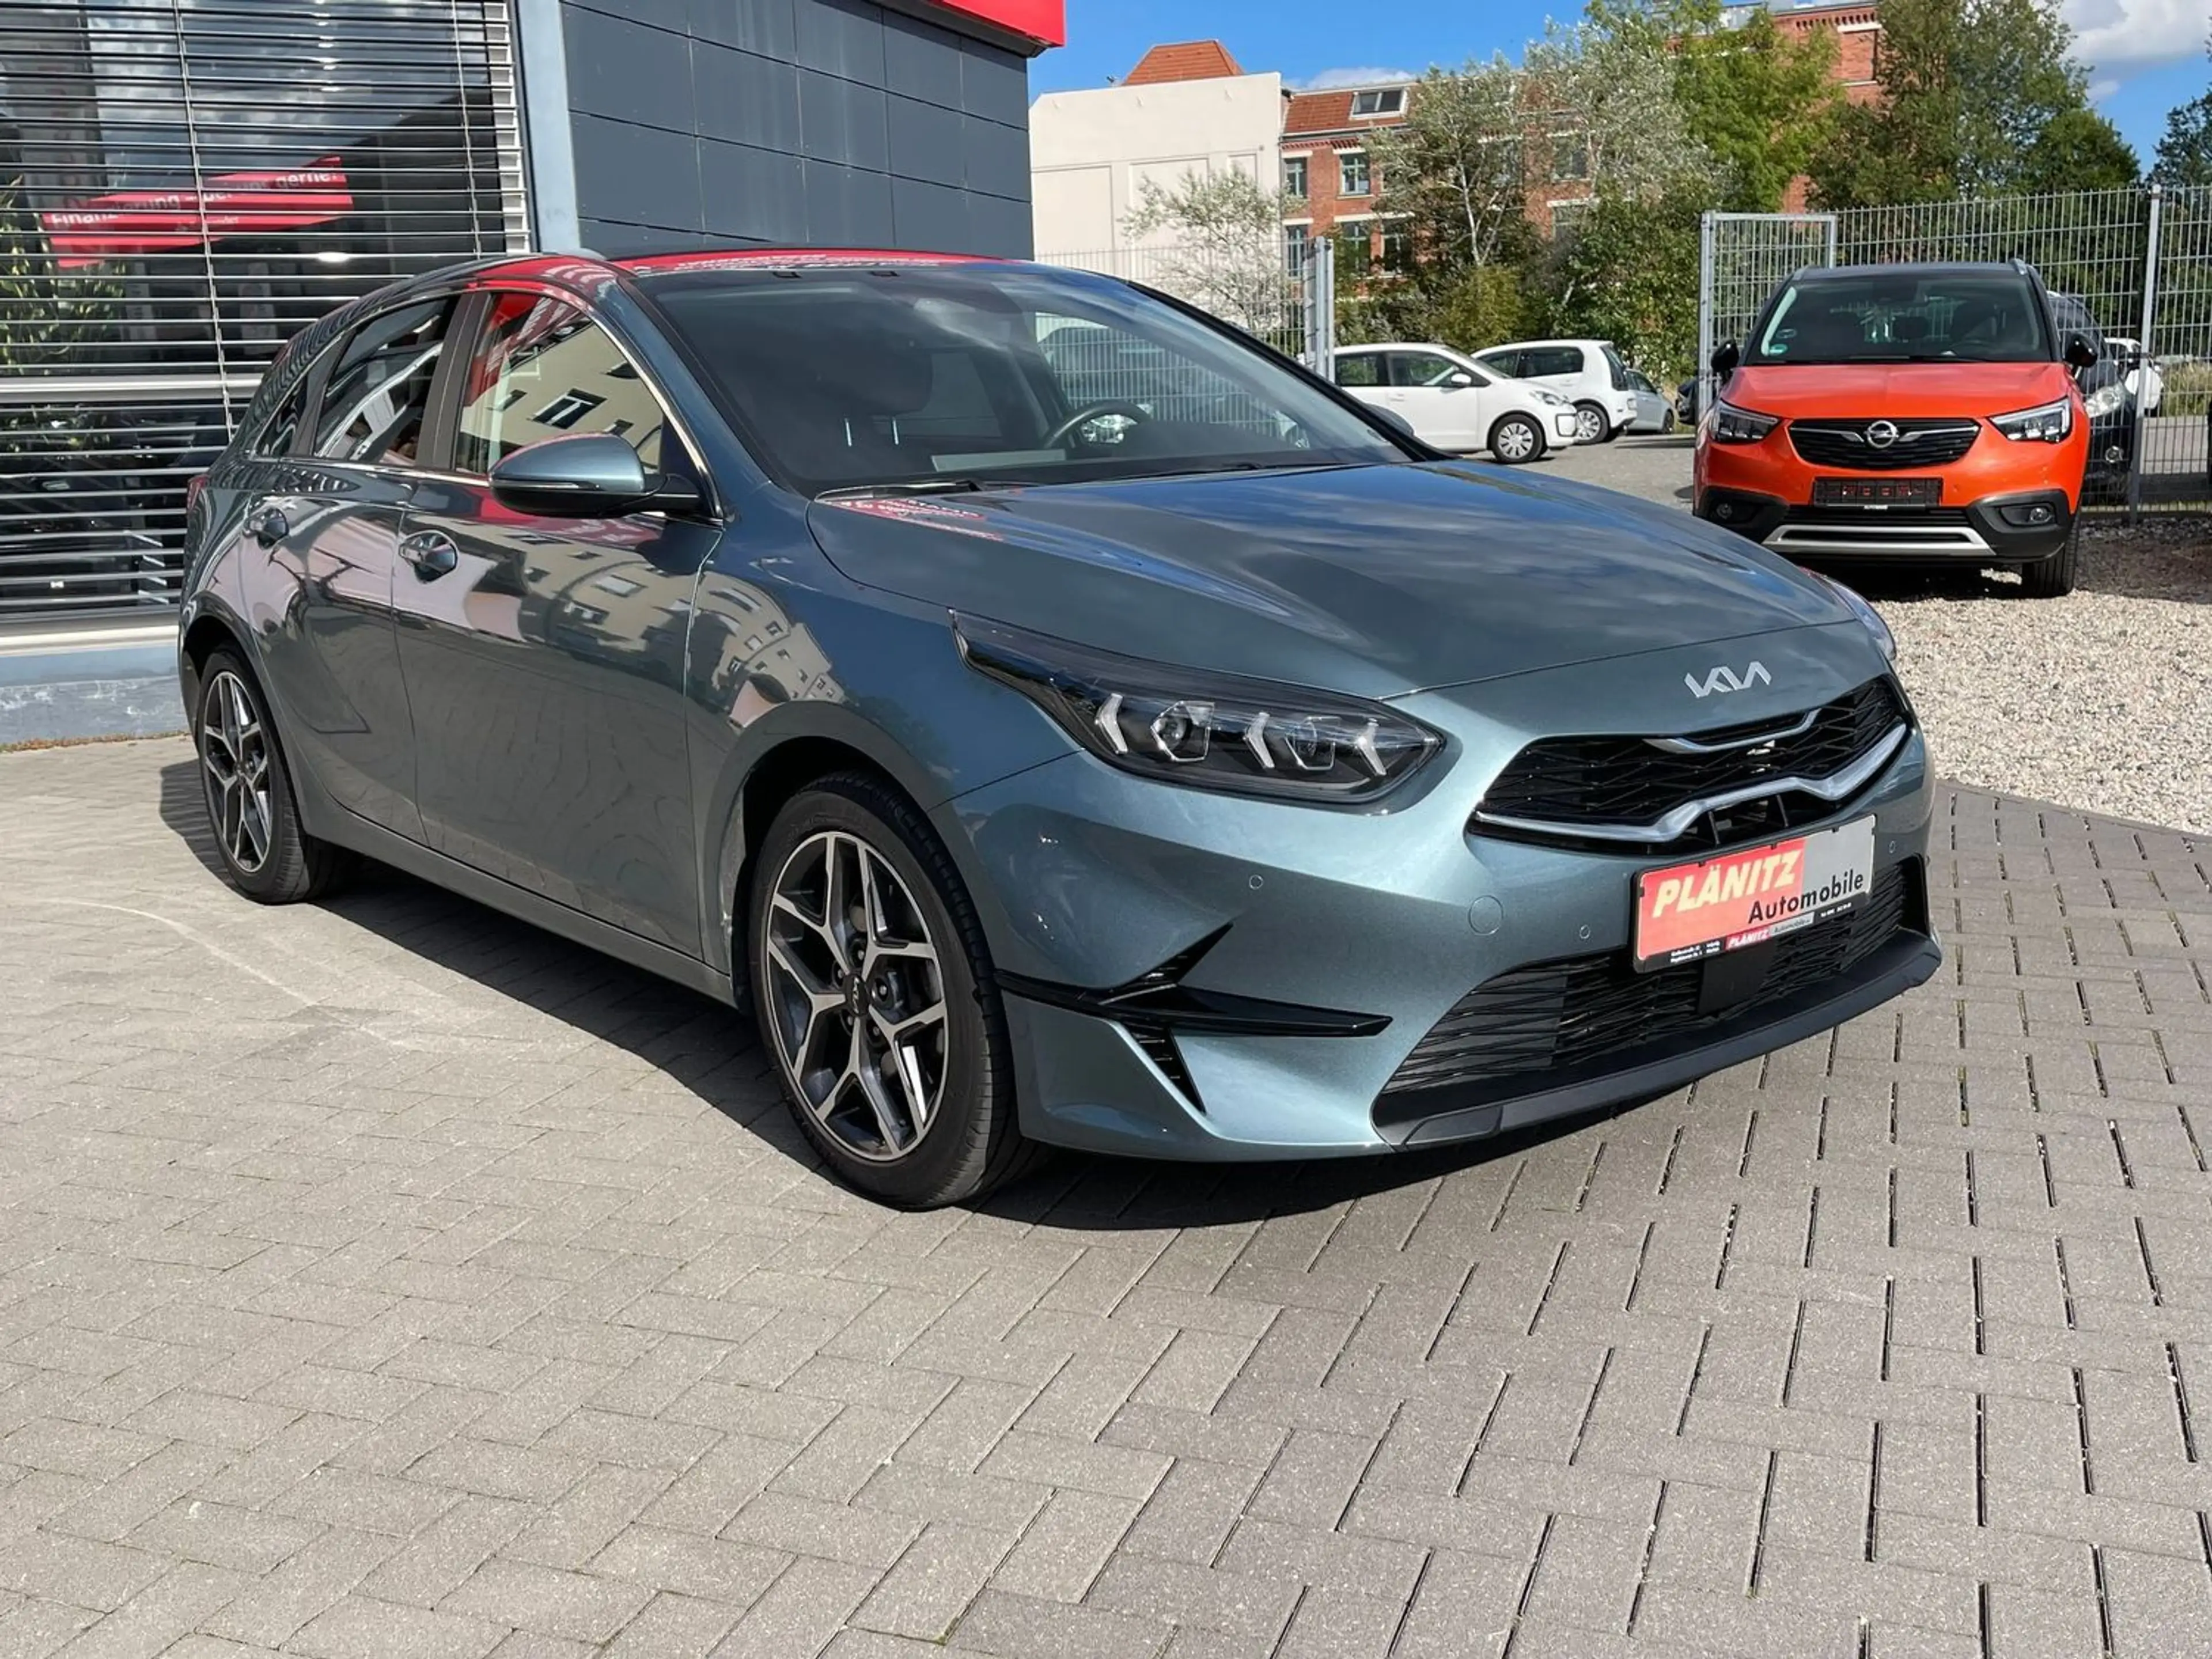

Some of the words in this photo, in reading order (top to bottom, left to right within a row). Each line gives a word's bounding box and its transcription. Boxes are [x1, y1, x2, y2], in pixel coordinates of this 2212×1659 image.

[1684, 661, 1772, 699] KIA
[1652, 849, 1802, 918] PLÄNITZ
[1748, 869, 1864, 923] Automobile
